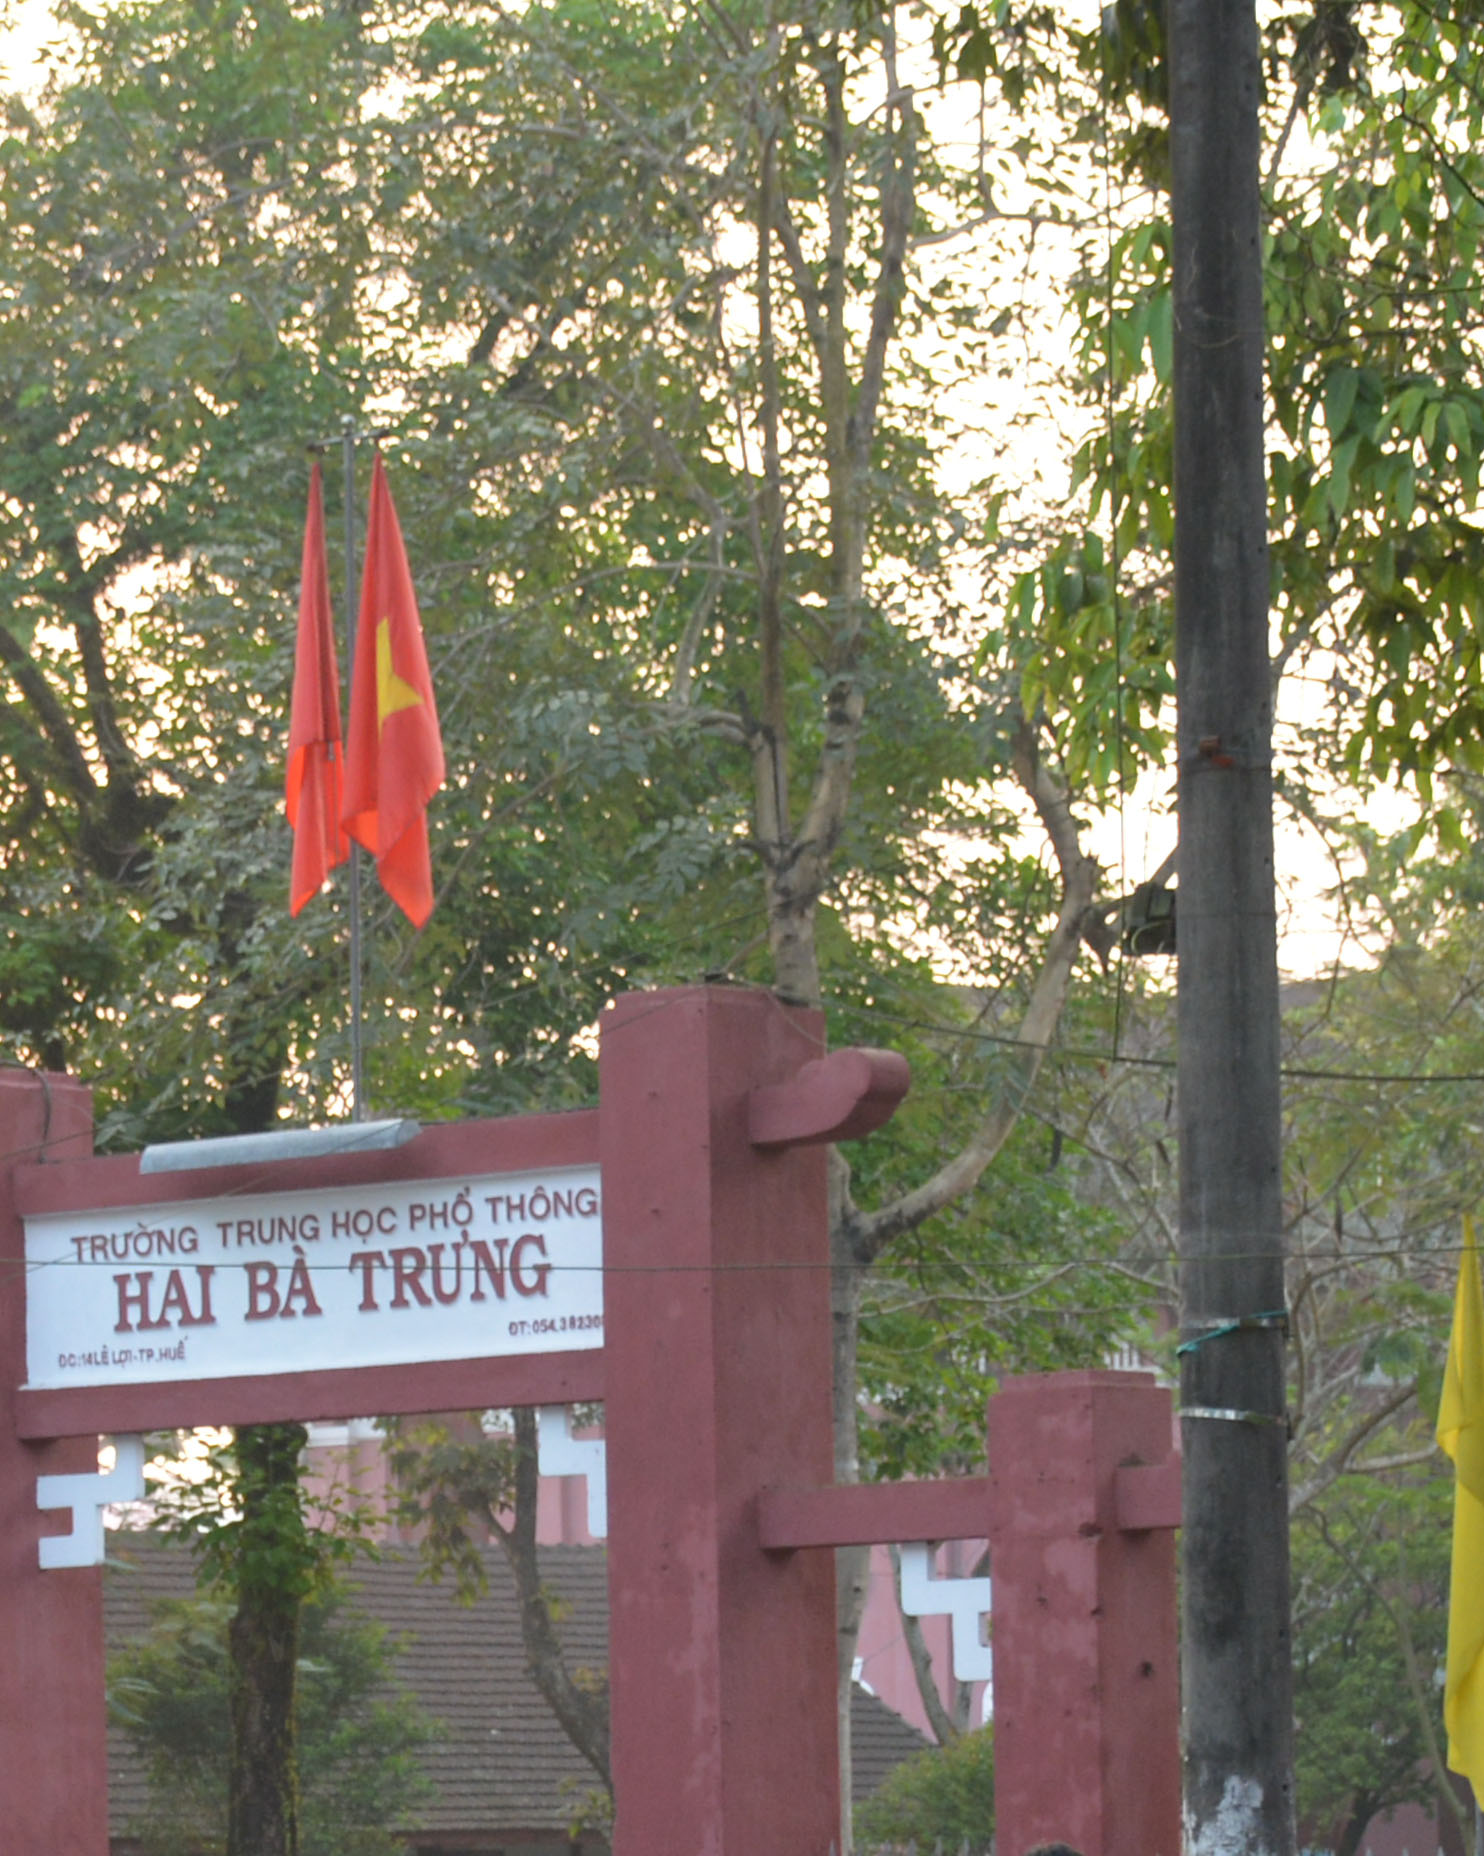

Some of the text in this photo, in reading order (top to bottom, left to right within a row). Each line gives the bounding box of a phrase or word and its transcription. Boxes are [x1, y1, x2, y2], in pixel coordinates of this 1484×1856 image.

[71, 1185, 599, 1263] TRƯỜNG TRUNG HỌC PHỔ THÔNG
[112, 1229, 553, 1333] HAI BÀ TRƯNG
